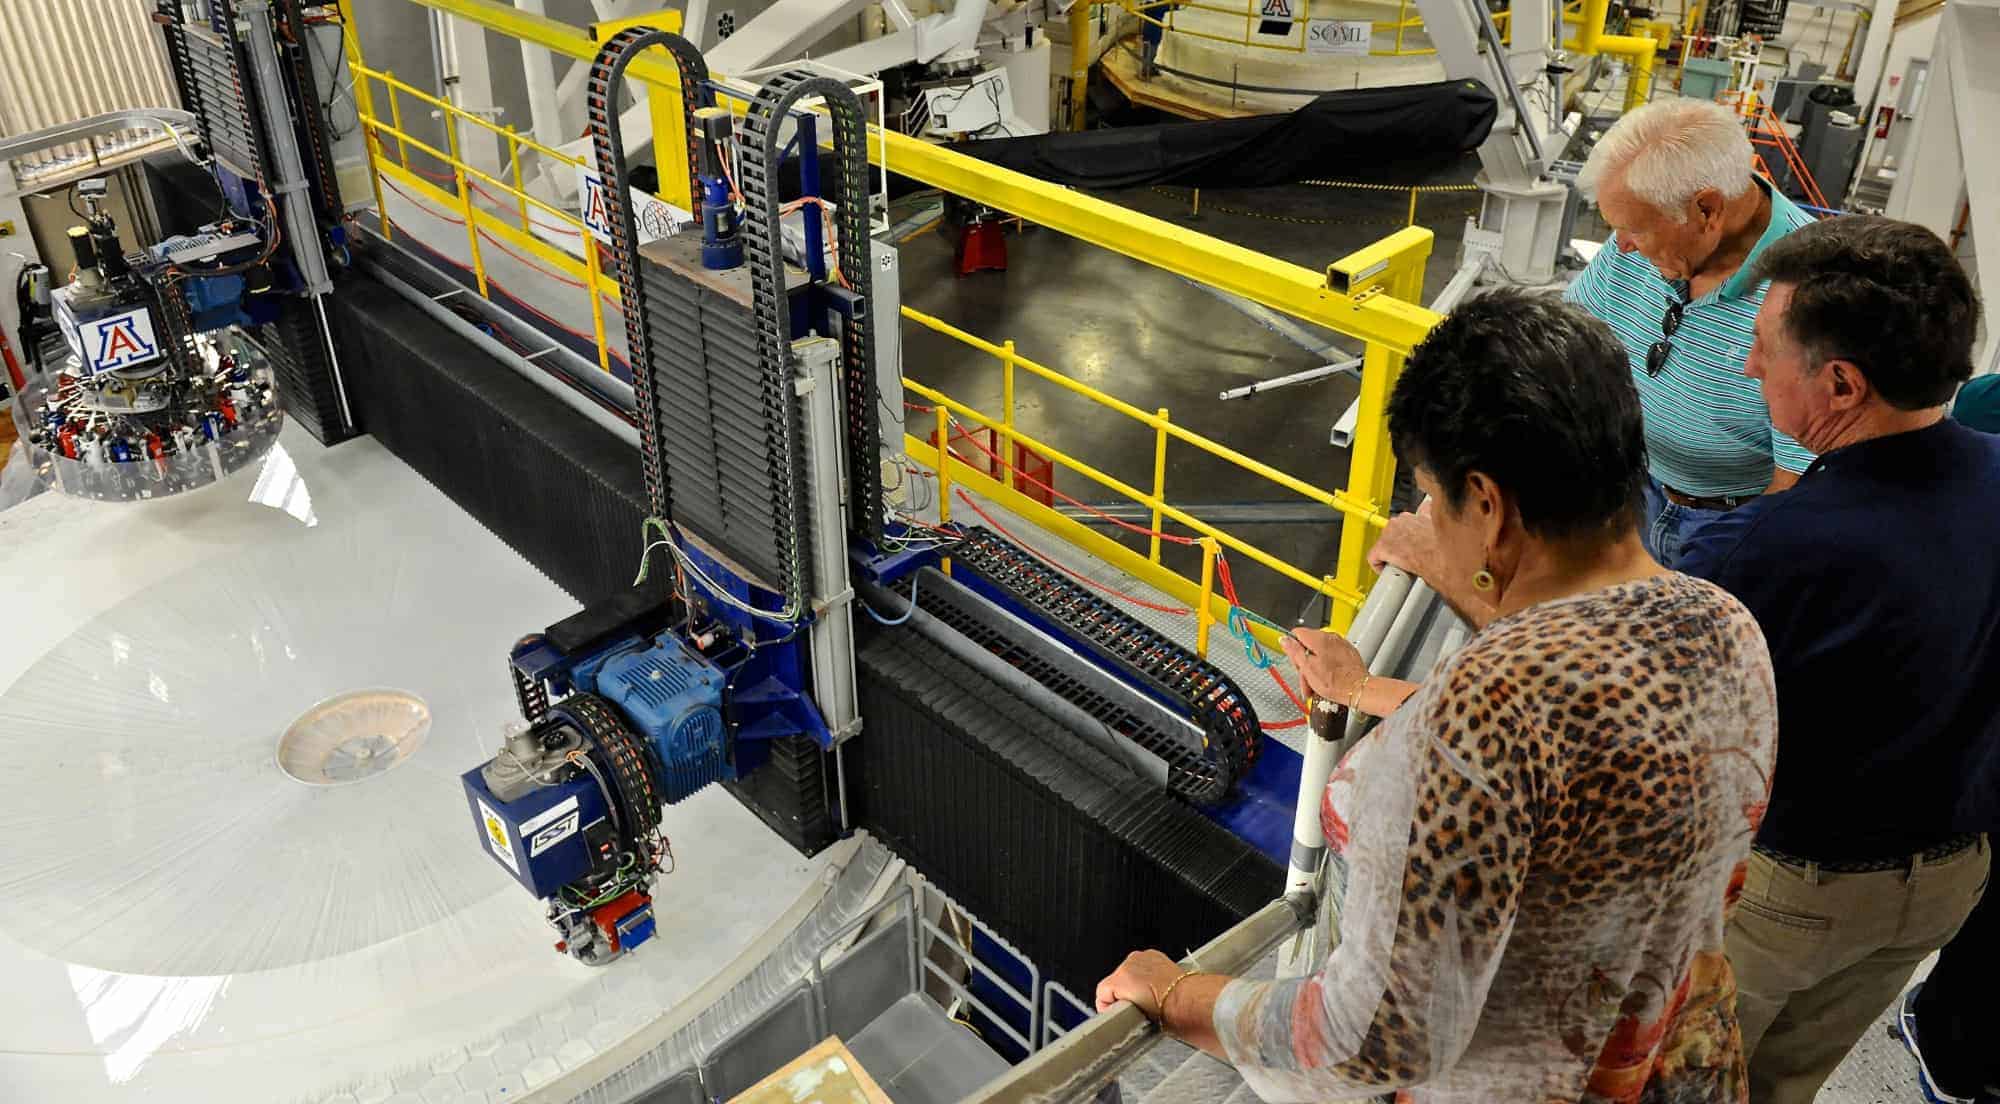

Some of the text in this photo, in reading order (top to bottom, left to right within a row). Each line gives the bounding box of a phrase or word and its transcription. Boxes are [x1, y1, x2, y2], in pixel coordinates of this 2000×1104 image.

[1262, 0, 1291, 17] A
[584, 175, 611, 236] A
[95, 316, 154, 371] A
